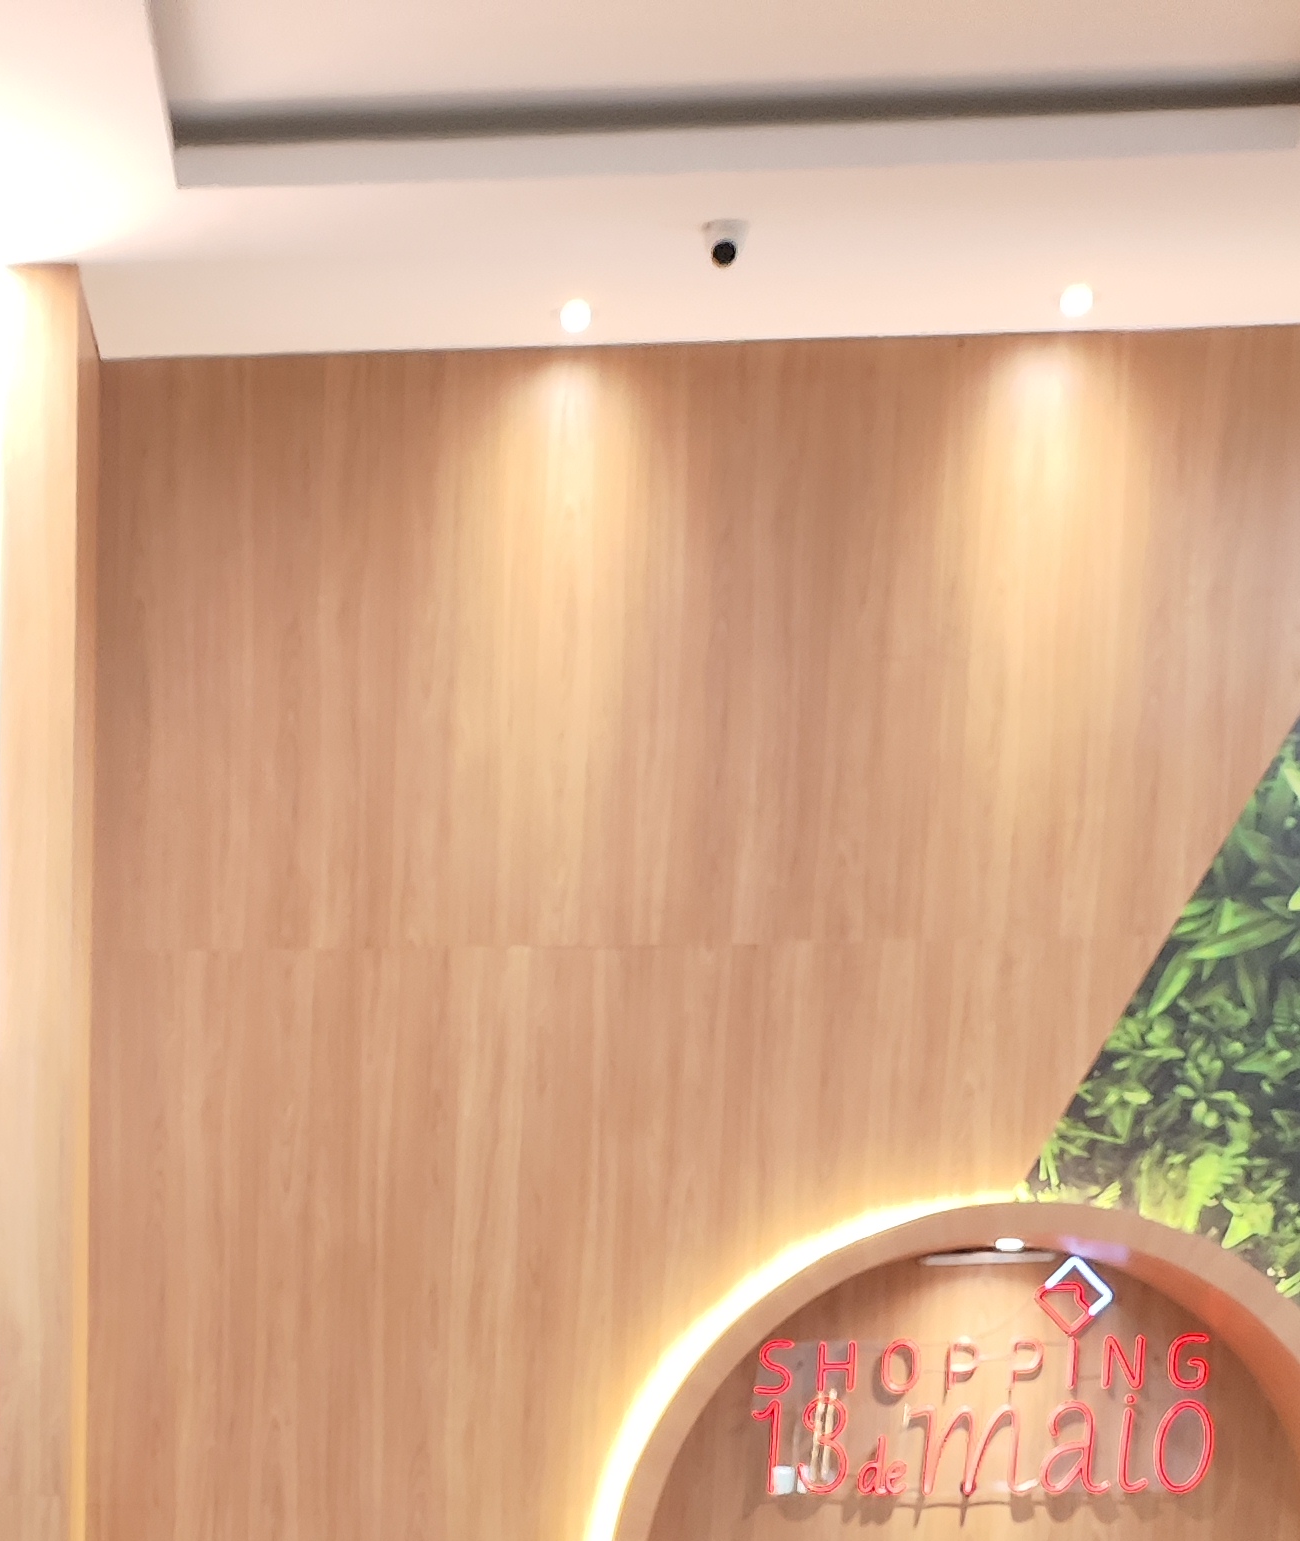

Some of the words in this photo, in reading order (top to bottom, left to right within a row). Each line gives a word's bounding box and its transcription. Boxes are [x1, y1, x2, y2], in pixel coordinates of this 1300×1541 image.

[753, 1333, 1211, 1396] SHOPPING
[751, 1396, 849, 1496] 13
[856, 1434, 908, 1496] de
[904, 1393, 1215, 1496] maio
